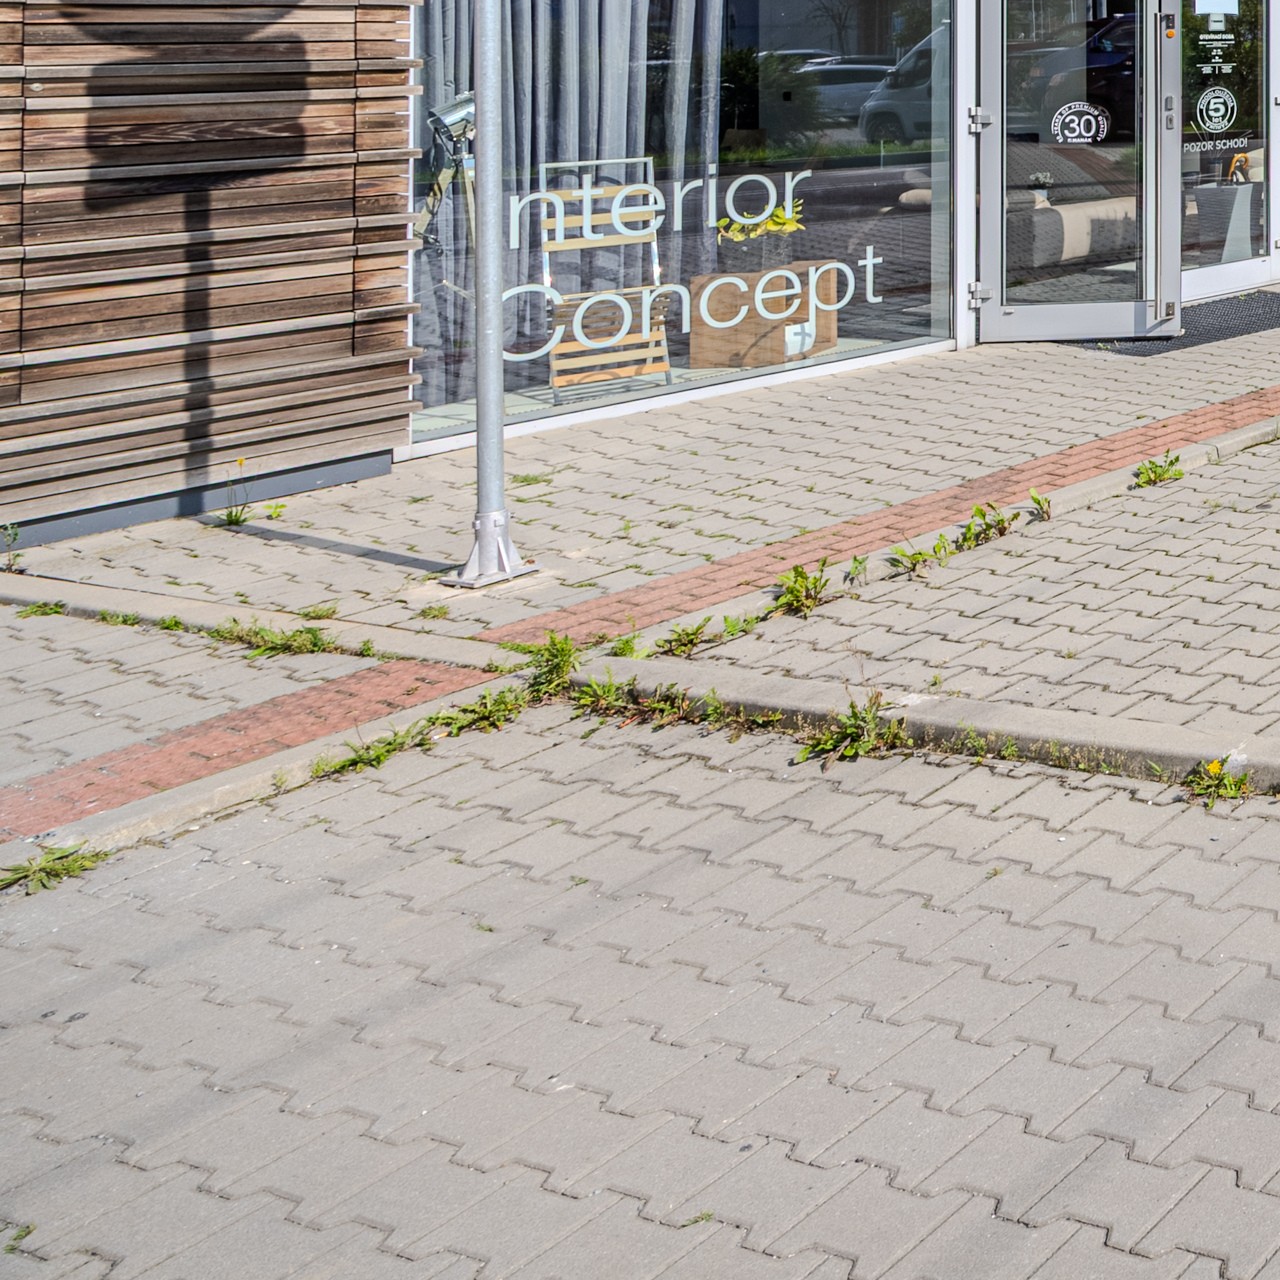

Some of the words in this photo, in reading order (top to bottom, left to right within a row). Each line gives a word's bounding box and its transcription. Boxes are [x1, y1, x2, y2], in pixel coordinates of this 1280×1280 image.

[1208, 98, 1225, 117] 5
[1064, 114, 1096, 138] 30
[1183, 141, 1214, 154] POZOR
[1215, 137, 1248, 150] SCHOD!
[509, 163, 813, 250] nterior
[502, 245, 884, 362] Concept
